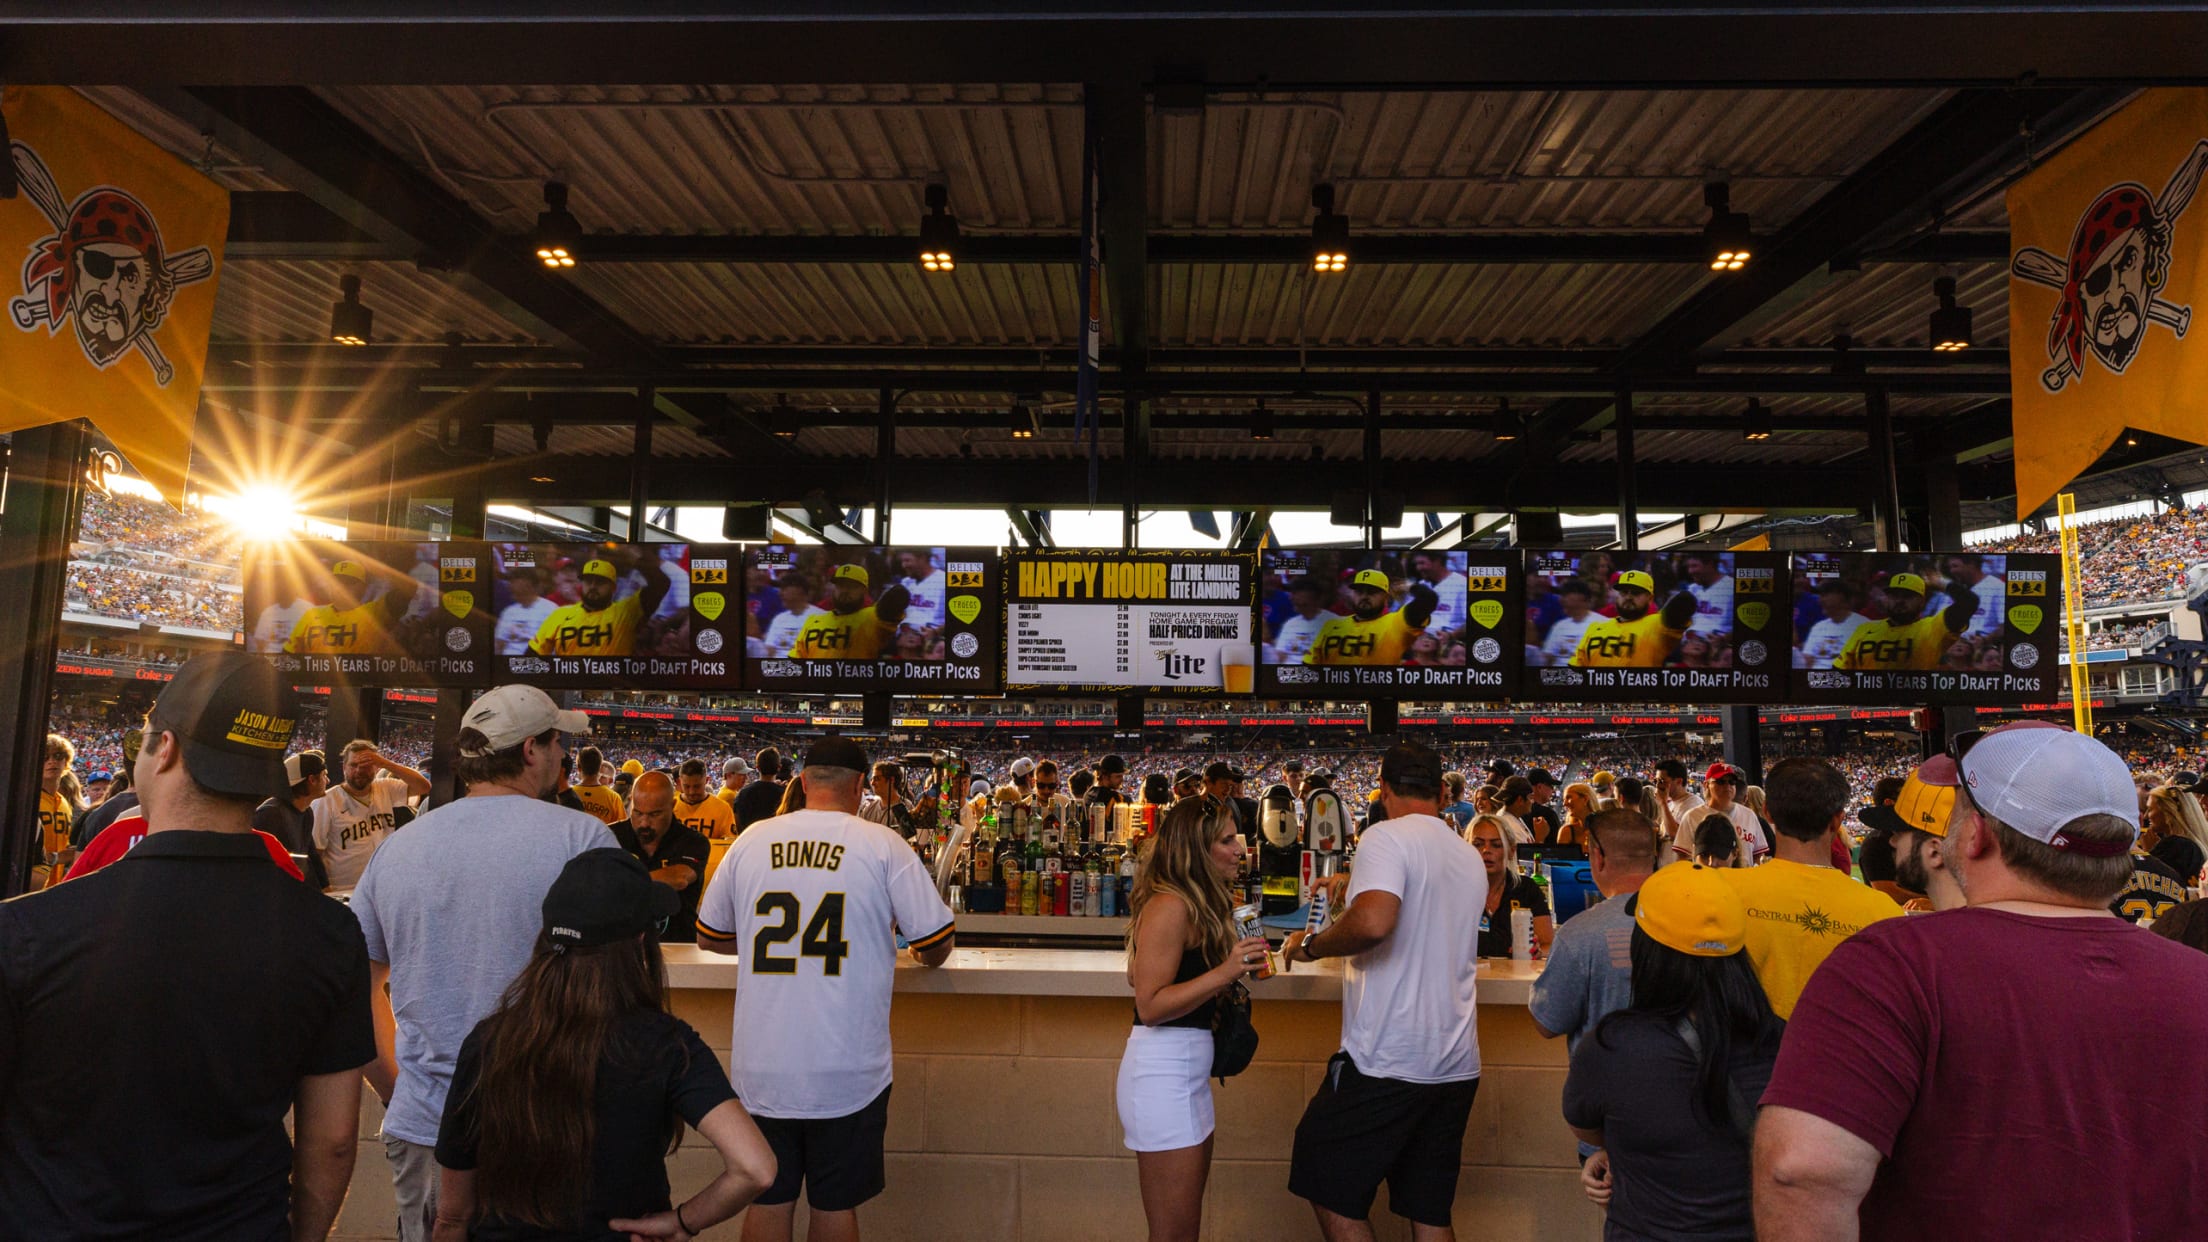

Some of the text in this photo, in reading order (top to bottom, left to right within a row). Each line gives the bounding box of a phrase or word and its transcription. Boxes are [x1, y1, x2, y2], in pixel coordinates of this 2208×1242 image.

[443, 558, 474, 567] BELL'S
[694, 560, 725, 569] BELL'S
[950, 563, 981, 572] BELL'S
[1170, 564, 1240, 582] AT THE MILLER
[1471, 567, 1504, 576] BELL'S
[2010, 572, 2044, 580] BELL'S
[1019, 562, 1167, 599] HAPPY HOUR
[1170, 582, 1240, 600] LITE LANDING
[307, 623, 357, 647] PGH
[560, 624, 613, 650] PGH
[805, 625, 850, 650] PGH
[1149, 625, 1239, 639] HALF PRICED DRINKS
[1323, 633, 1375, 657] PGH
[1587, 633, 1635, 661] PGH
[1858, 638, 1913, 663] PGH
[56, 664, 114, 677] ZERO SUGAR
[304, 656, 474, 673] THIS YEARS TOP DRAFT PICKS
[553, 658, 579, 674] THIS
[583, 658, 620, 674] YEARS
[624, 659, 646, 674] TOP
[651, 659, 687, 674] DRAFT
[691, 659, 725, 675] PICKS
[806, 661, 832, 677] THIS
[836, 662, 873, 678] YEARS
[878, 662, 900, 678] TOP
[905, 663, 942, 679] DRAFT
[946, 663, 981, 679] PICKS
[1163, 653, 1206, 680] Lite
[136, 668, 162, 681] Coke
[1323, 668, 1350, 684] THIS
[1354, 668, 1392, 684] YEARS
[1396, 668, 1420, 684] TOP
[1425, 668, 1463, 685] DRAFT
[1467, 668, 1502, 685] PICKS
[1587, 669, 1614, 686] THIS
[1618, 670, 1657, 686] YEARS
[1662, 670, 1686, 687] TOP
[1690, 670, 1729, 687] DRAFT
[1733, 671, 1769, 687] PICKS
[1855, 672, 1882, 689] THIS
[1887, 673, 1927, 689] YEARS
[1931, 673, 1956, 689] TOP
[1960, 674, 2000, 690] DRAFT
[2004, 674, 2041, 691] PICKS
[235, 708, 269, 730] JASON
[1452, 716, 1472, 725] Coke
[1530, 715, 1550, 724] Coke
[1611, 715, 1632, 724] Coke
[1696, 715, 1720, 724] Coke
[1780, 714, 1799, 723] Coke
[1851, 709, 1871, 719] Coke
[231, 725, 275, 741] KITCHEN
[340, 812, 395, 850] PIRATE
[681, 818, 715, 838] GH
[771, 840, 846, 872] BONDS
[1747, 907, 1792, 922] CENTRAL
[752, 890, 850, 976] 24
